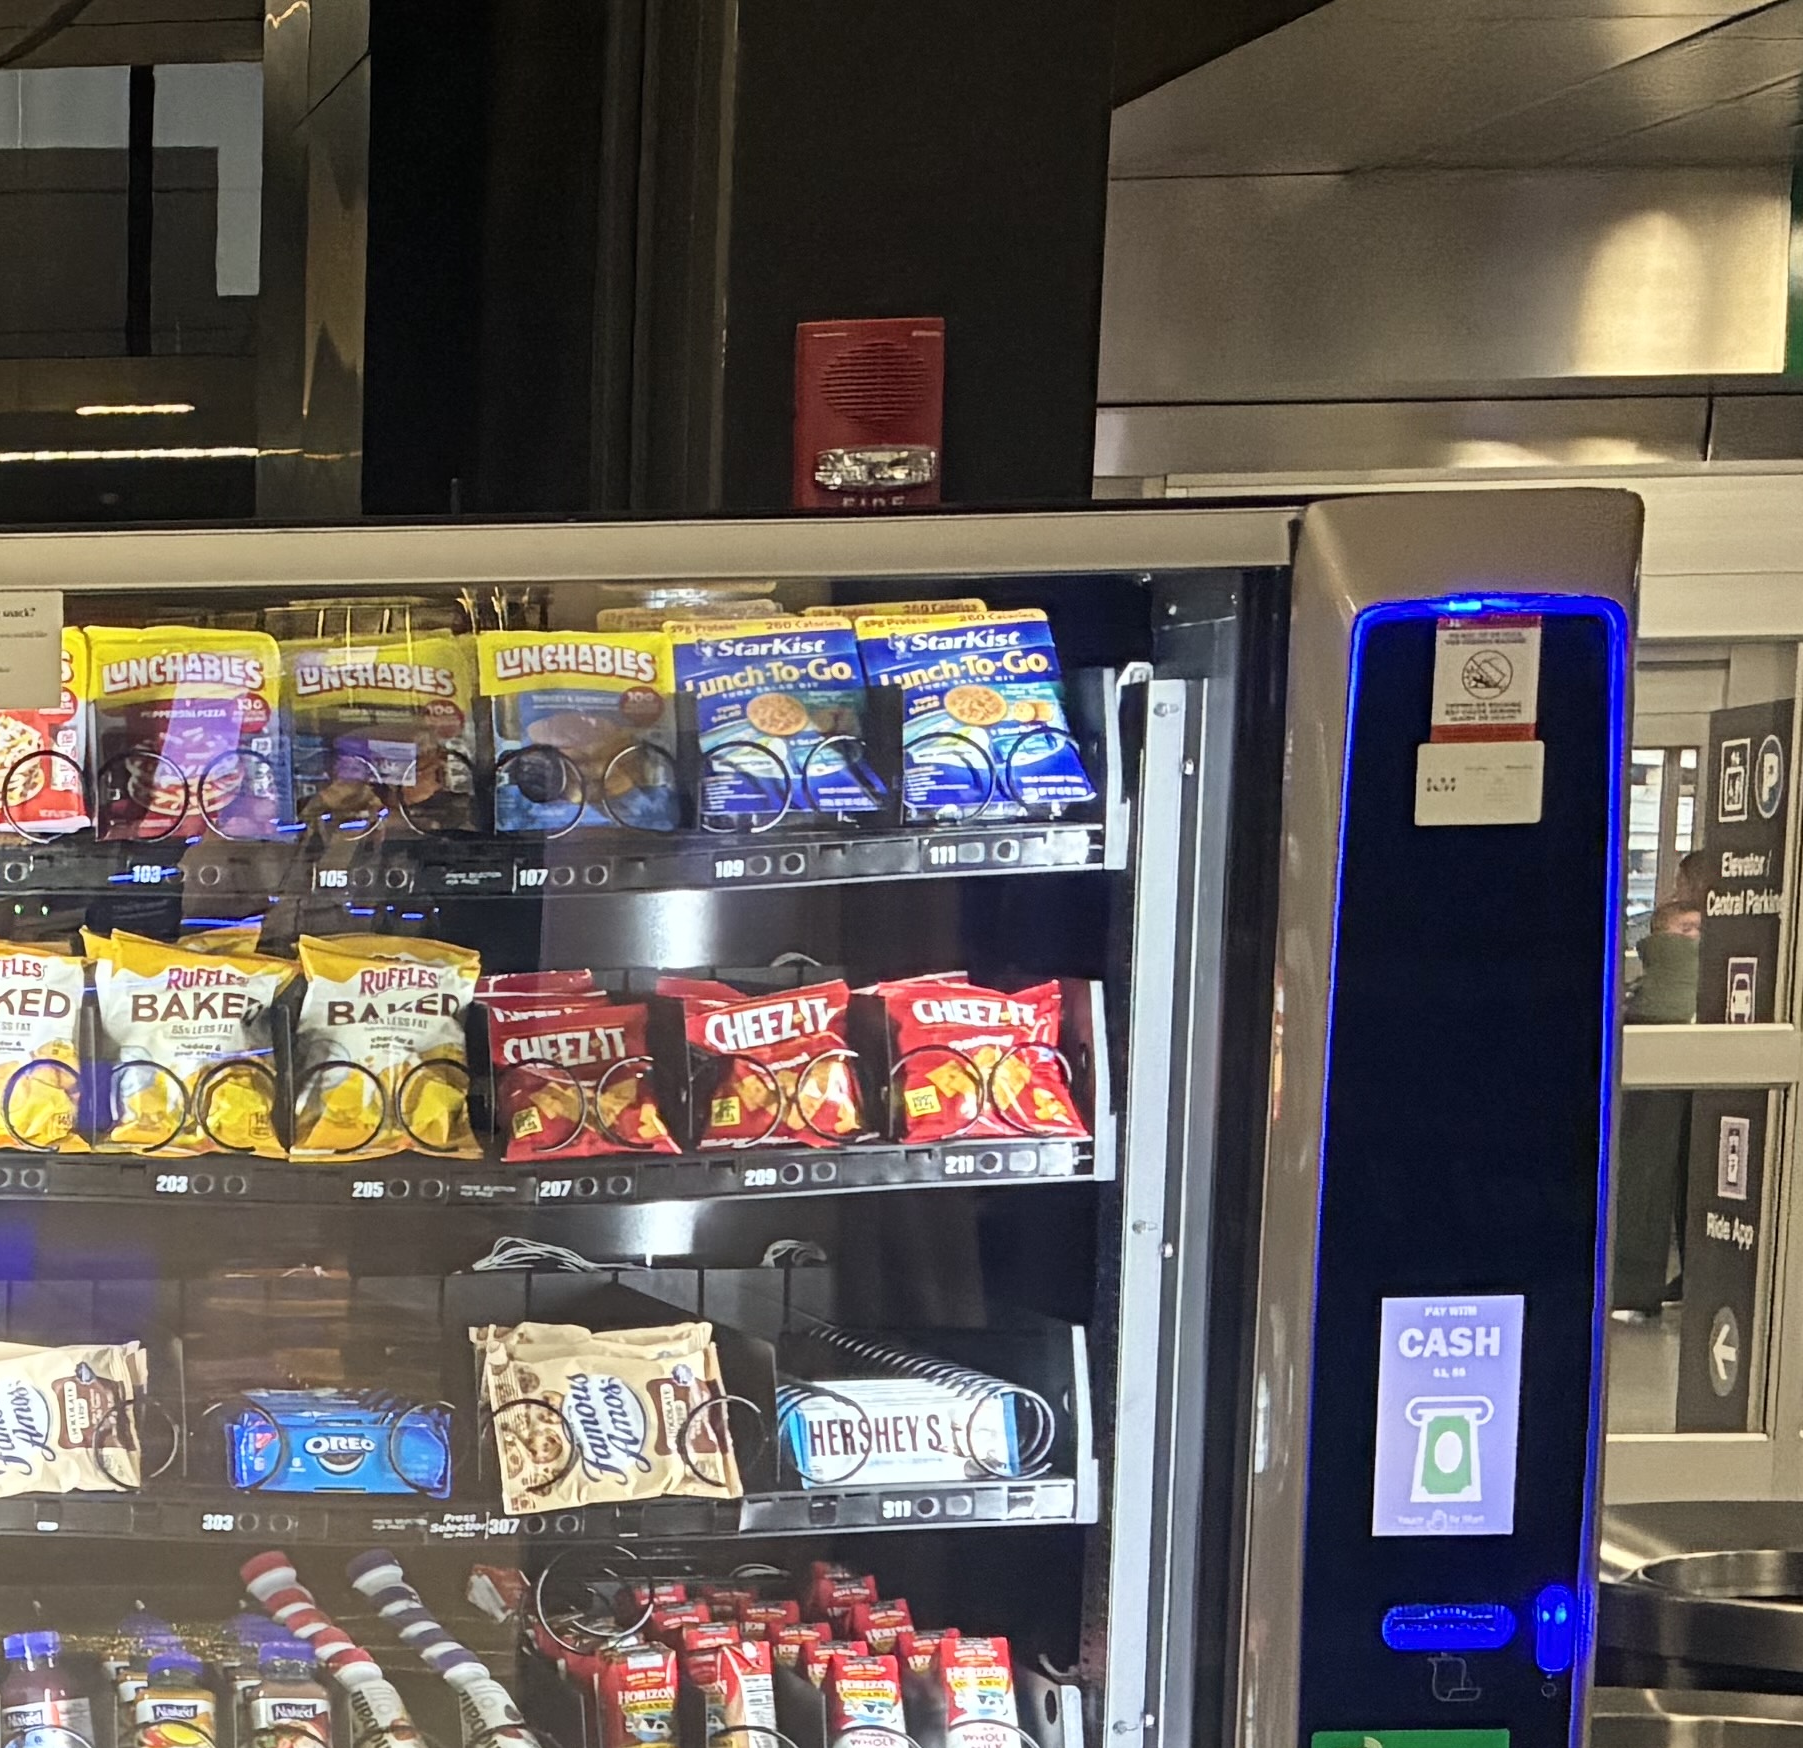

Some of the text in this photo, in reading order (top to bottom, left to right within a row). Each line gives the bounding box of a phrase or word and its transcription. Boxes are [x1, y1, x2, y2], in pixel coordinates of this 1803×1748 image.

[717, 636, 827, 657] StarKist
[910, 629, 1020, 650] StarKist
[103, 651, 264, 692] LUNCHABLES
[496, 645, 656, 682] LUNCHABLES
[296, 655, 454, 696] LUNCHABLES
[1722, 851, 1766, 879] Elevator
[319, 869, 347, 887] 105
[520, 867, 547, 887] 107
[1707, 889, 1743, 916] Central
[359, 968, 439, 995] RUFFLES
[157, 1175, 188, 1194] 203
[353, 1181, 384, 1198] 205
[1707, 1212, 1754, 1248] Ride App
[1425, 1306, 1446, 1317] PAY
[1398, 1326, 1501, 1358] CASH
[303, 1435, 375, 1454] OREO
[617, 1689, 674, 1702] HORIZON
[155, 1705, 195, 1718] Naked
[274, 1705, 313, 1718] Naked
[849, 1738, 896, 1748] WHOLE
